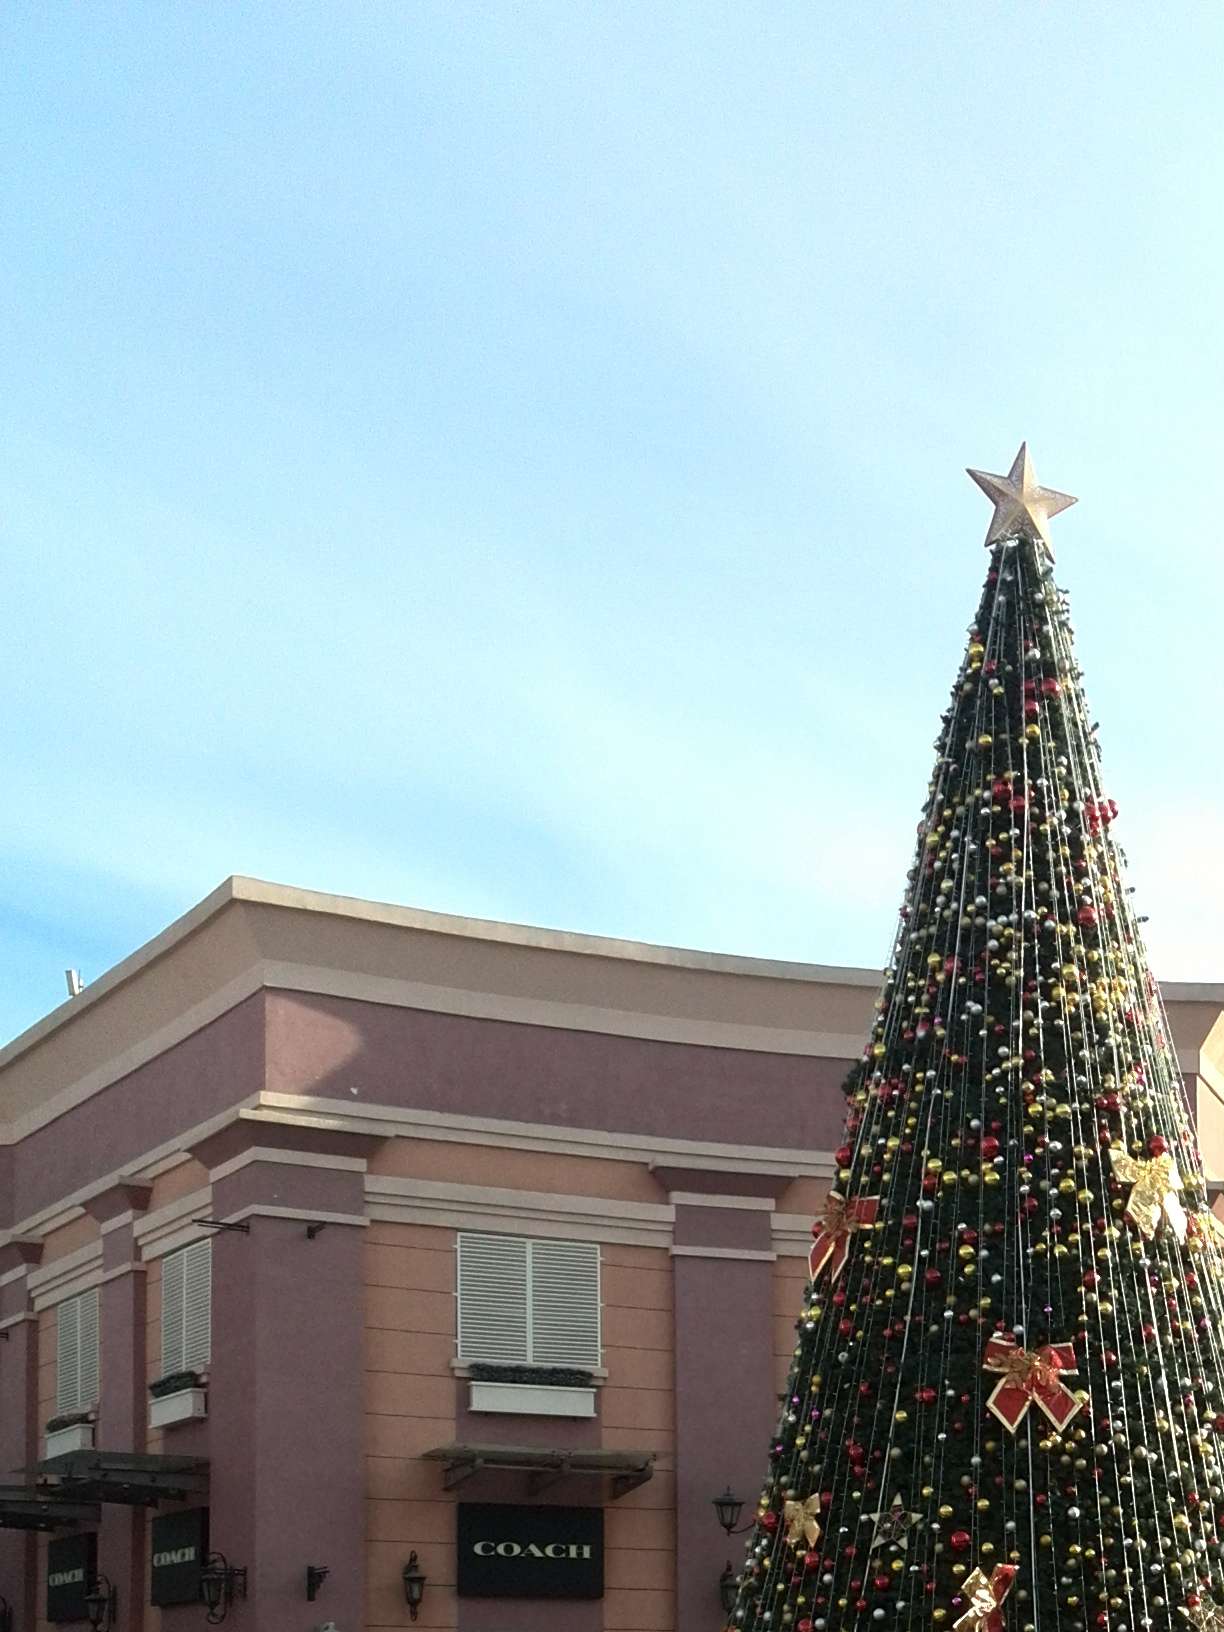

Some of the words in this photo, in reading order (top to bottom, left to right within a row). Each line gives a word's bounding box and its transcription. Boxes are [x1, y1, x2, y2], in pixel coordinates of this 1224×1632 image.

[153, 1547, 195, 1567] COACH
[473, 1541, 592, 1559] COACH
[49, 1568, 84, 1586] COACH
